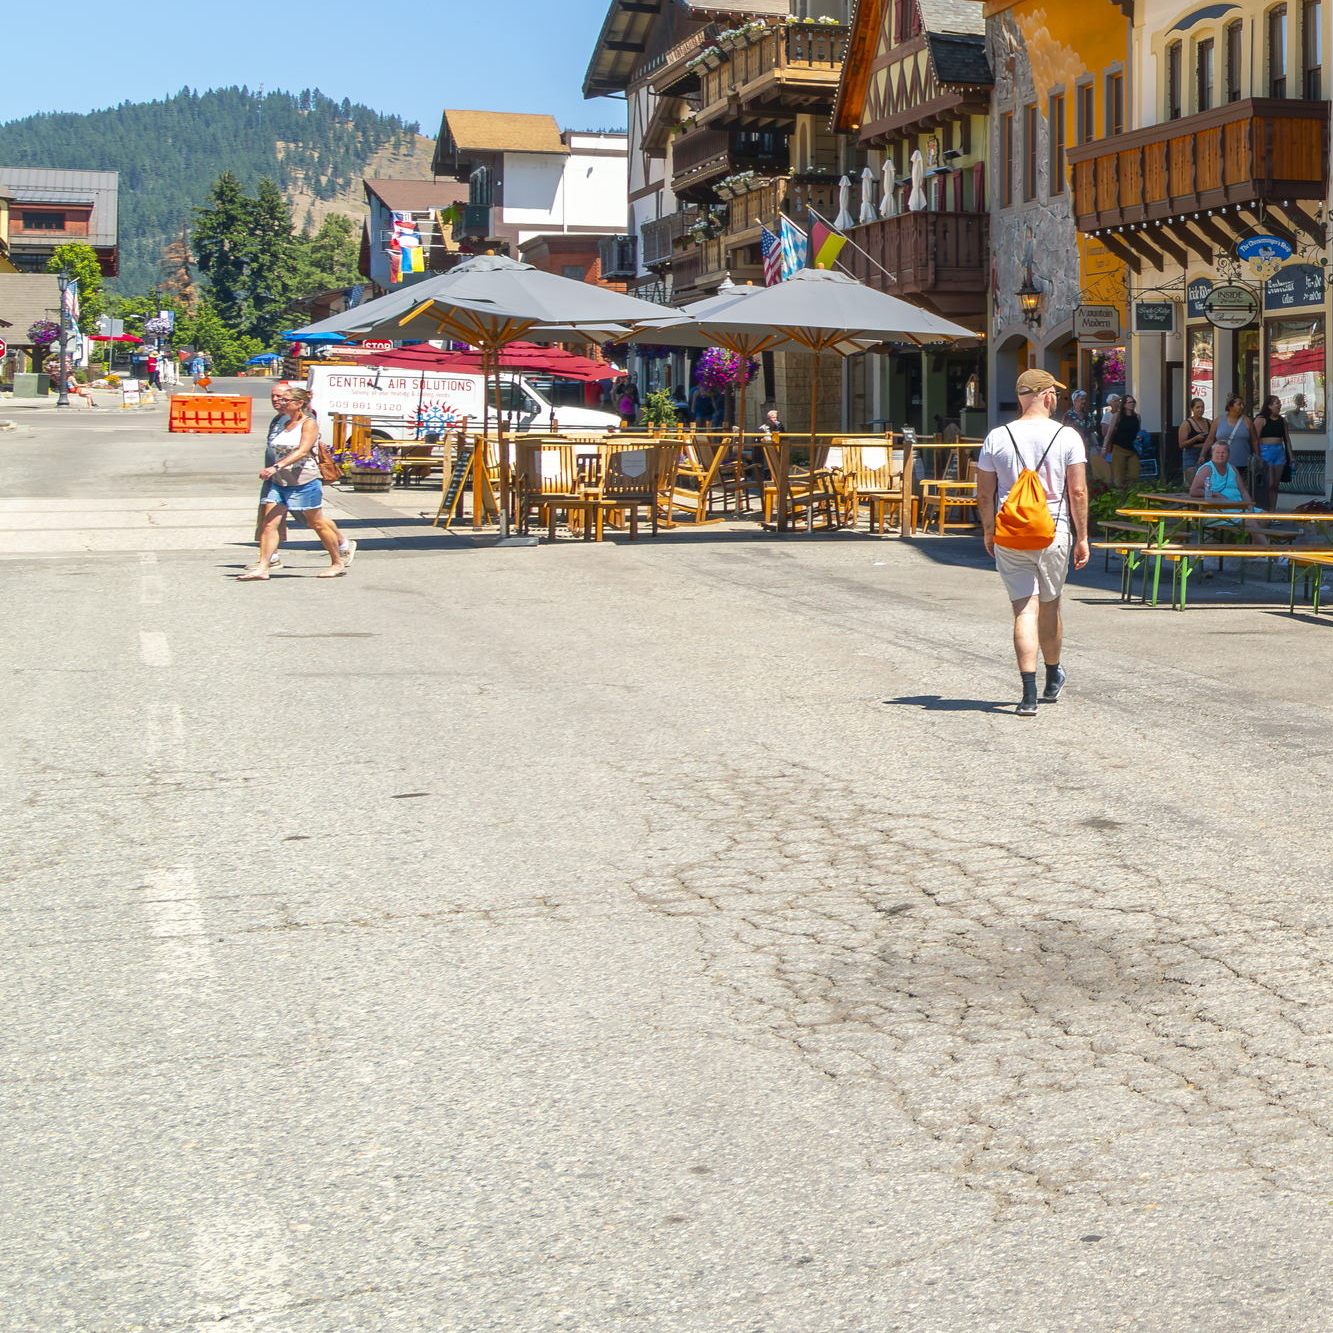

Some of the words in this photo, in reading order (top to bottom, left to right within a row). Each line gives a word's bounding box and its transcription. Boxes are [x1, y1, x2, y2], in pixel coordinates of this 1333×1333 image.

[1217, 291, 1243, 299] INSIDE
[1078, 308, 1114, 318] Mountain
[1082, 318, 1111, 327] Modern
[329, 376, 377, 388] CENTRA
[388, 379, 407, 389] AIR
[412, 379, 472, 392] SOLUTIONS
